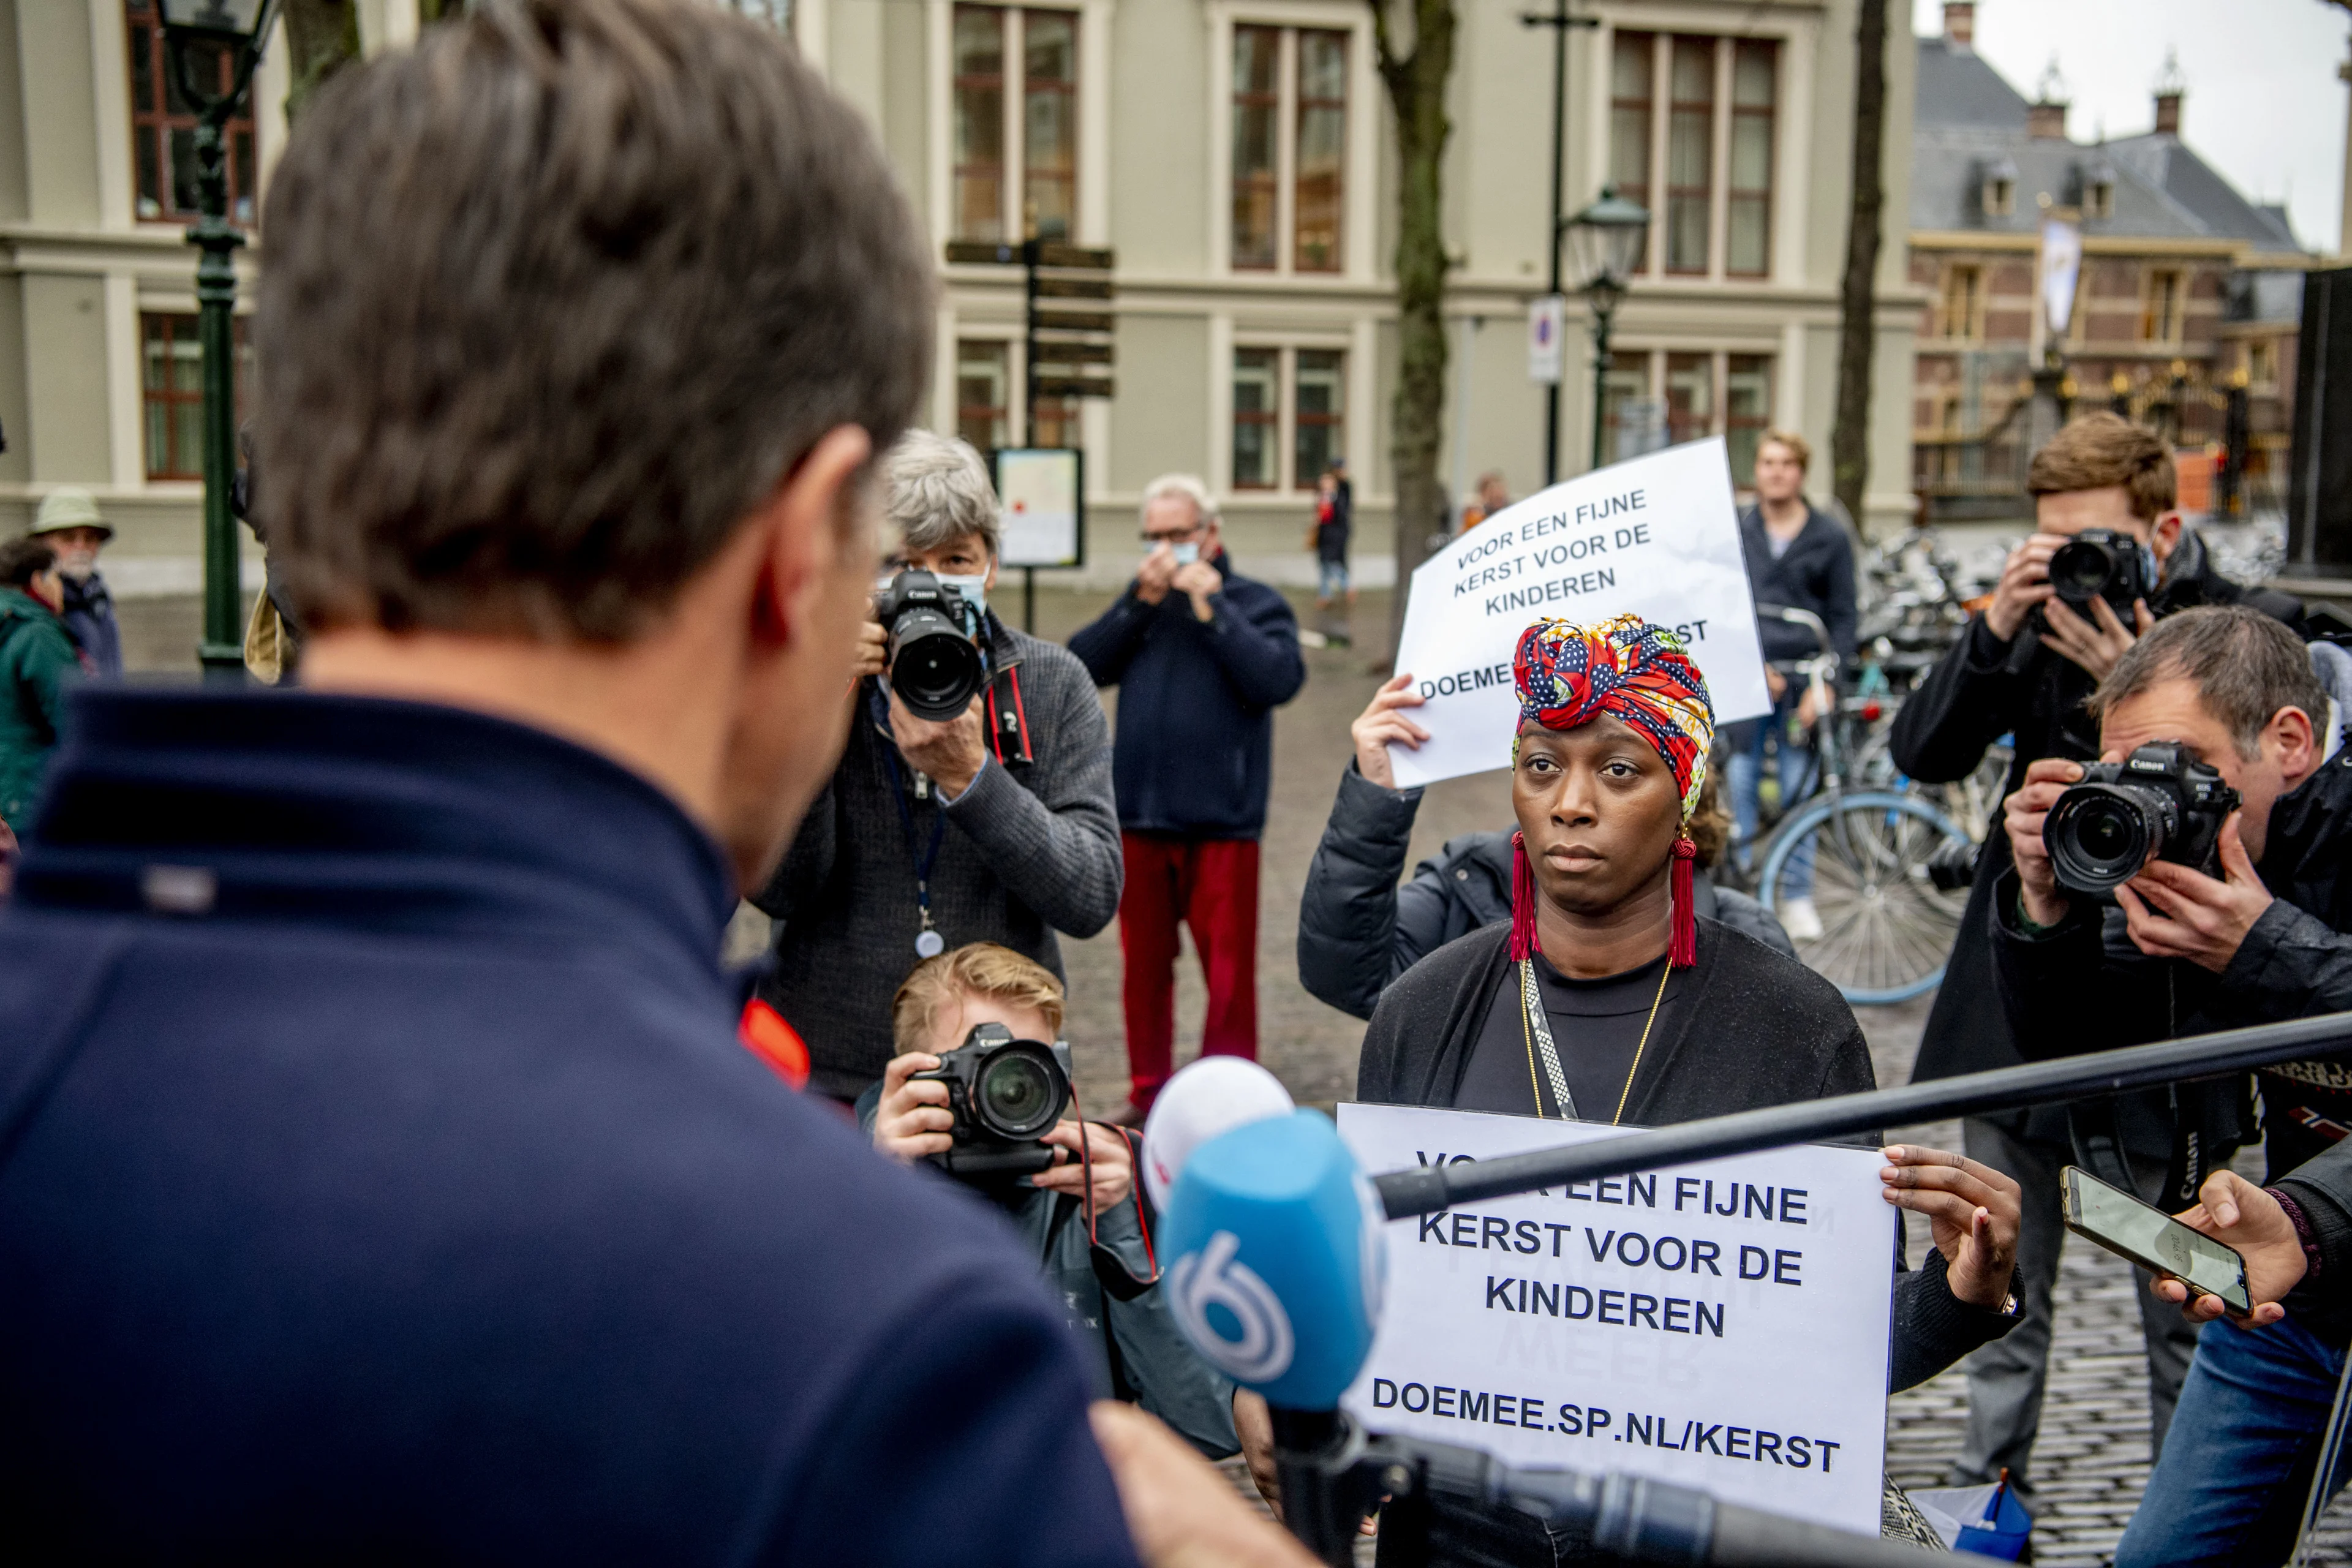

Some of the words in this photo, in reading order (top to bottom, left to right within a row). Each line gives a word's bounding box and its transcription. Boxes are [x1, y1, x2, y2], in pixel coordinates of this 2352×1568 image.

[1453, 557, 1524, 597] KERST
[1534, 534, 1607, 570] VOOR
[1615, 523, 1651, 548] DE
[1458, 530, 1513, 570] VOOR
[1521, 512, 1567, 541] EEN
[1576, 489, 1646, 524] FIJNE
[908, 589, 937, 600] Canon
[1485, 567, 1616, 616] KINDEREN
[1420, 662, 1516, 700] DOEME
[2130, 758, 2165, 771] Canon
[2180, 1131, 2199, 1200] Canon
[1675, 1177, 1808, 1224] FIJNE
[1419, 1211, 1571, 1257] KERST
[1585, 1227, 1722, 1276] VOOR
[1740, 1245, 1803, 1286] DE
[1487, 1276, 1725, 1337] KINDEREN
[1373, 1378, 1841, 1472] DOEMEE.SP.NL/KERST
